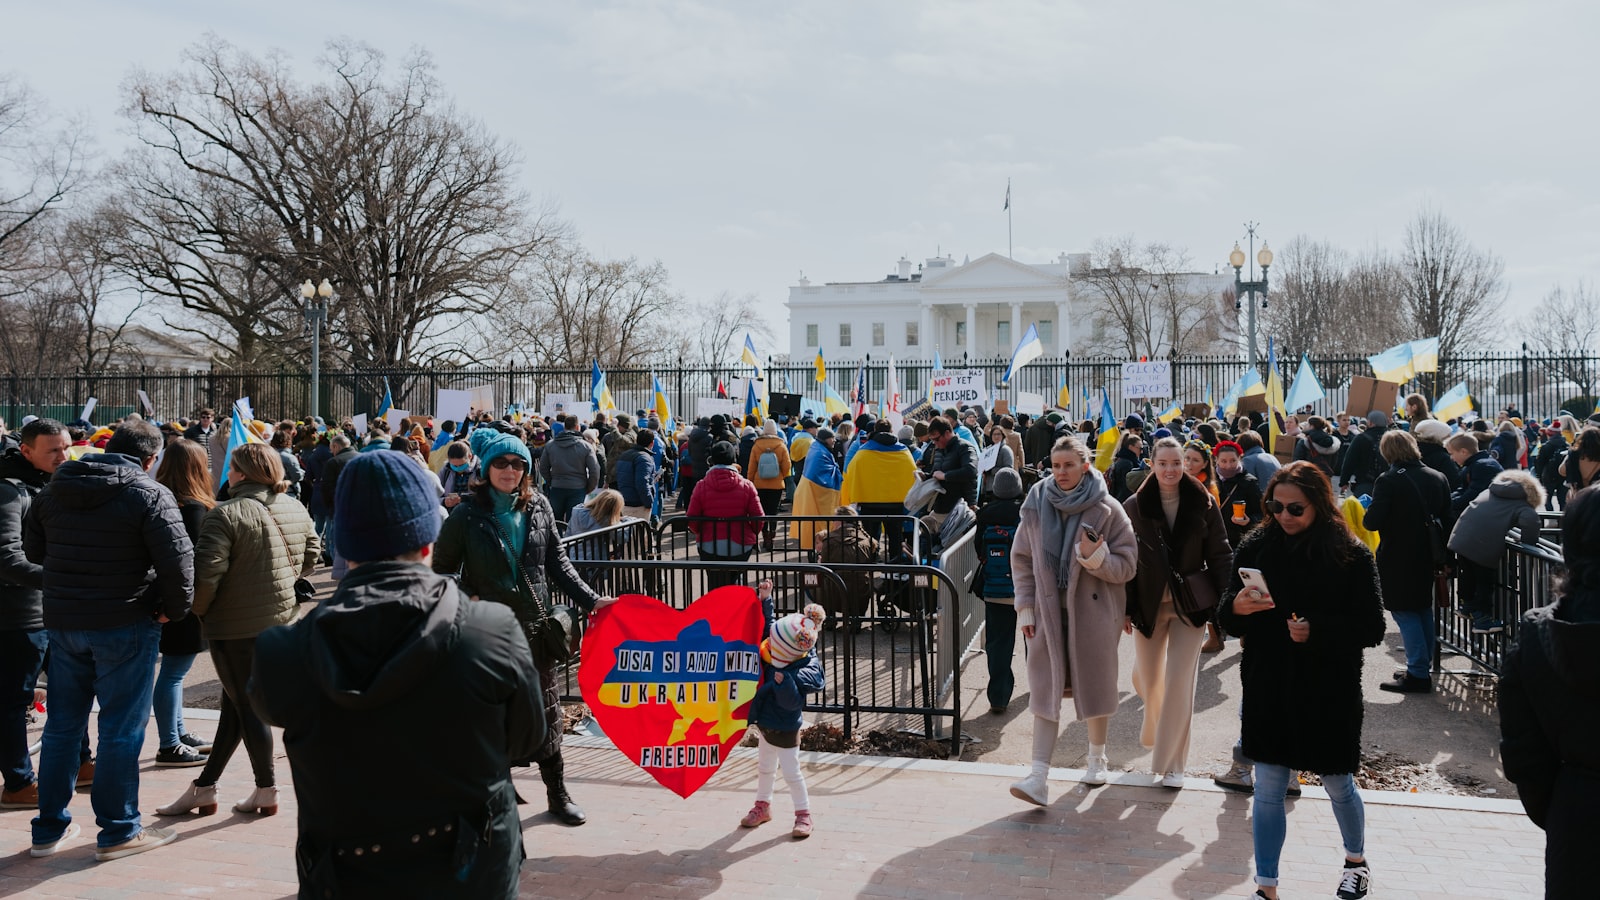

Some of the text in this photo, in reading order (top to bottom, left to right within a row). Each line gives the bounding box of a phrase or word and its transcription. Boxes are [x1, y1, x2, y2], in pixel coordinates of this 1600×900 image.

[968, 369, 982, 377] HAS
[934, 376, 972, 387] NOT YET
[934, 389, 978, 402] PERISHED
[619, 651, 652, 670] USA
[621, 681, 737, 703] UKRAINE
[642, 745, 719, 767] FREEDOM
